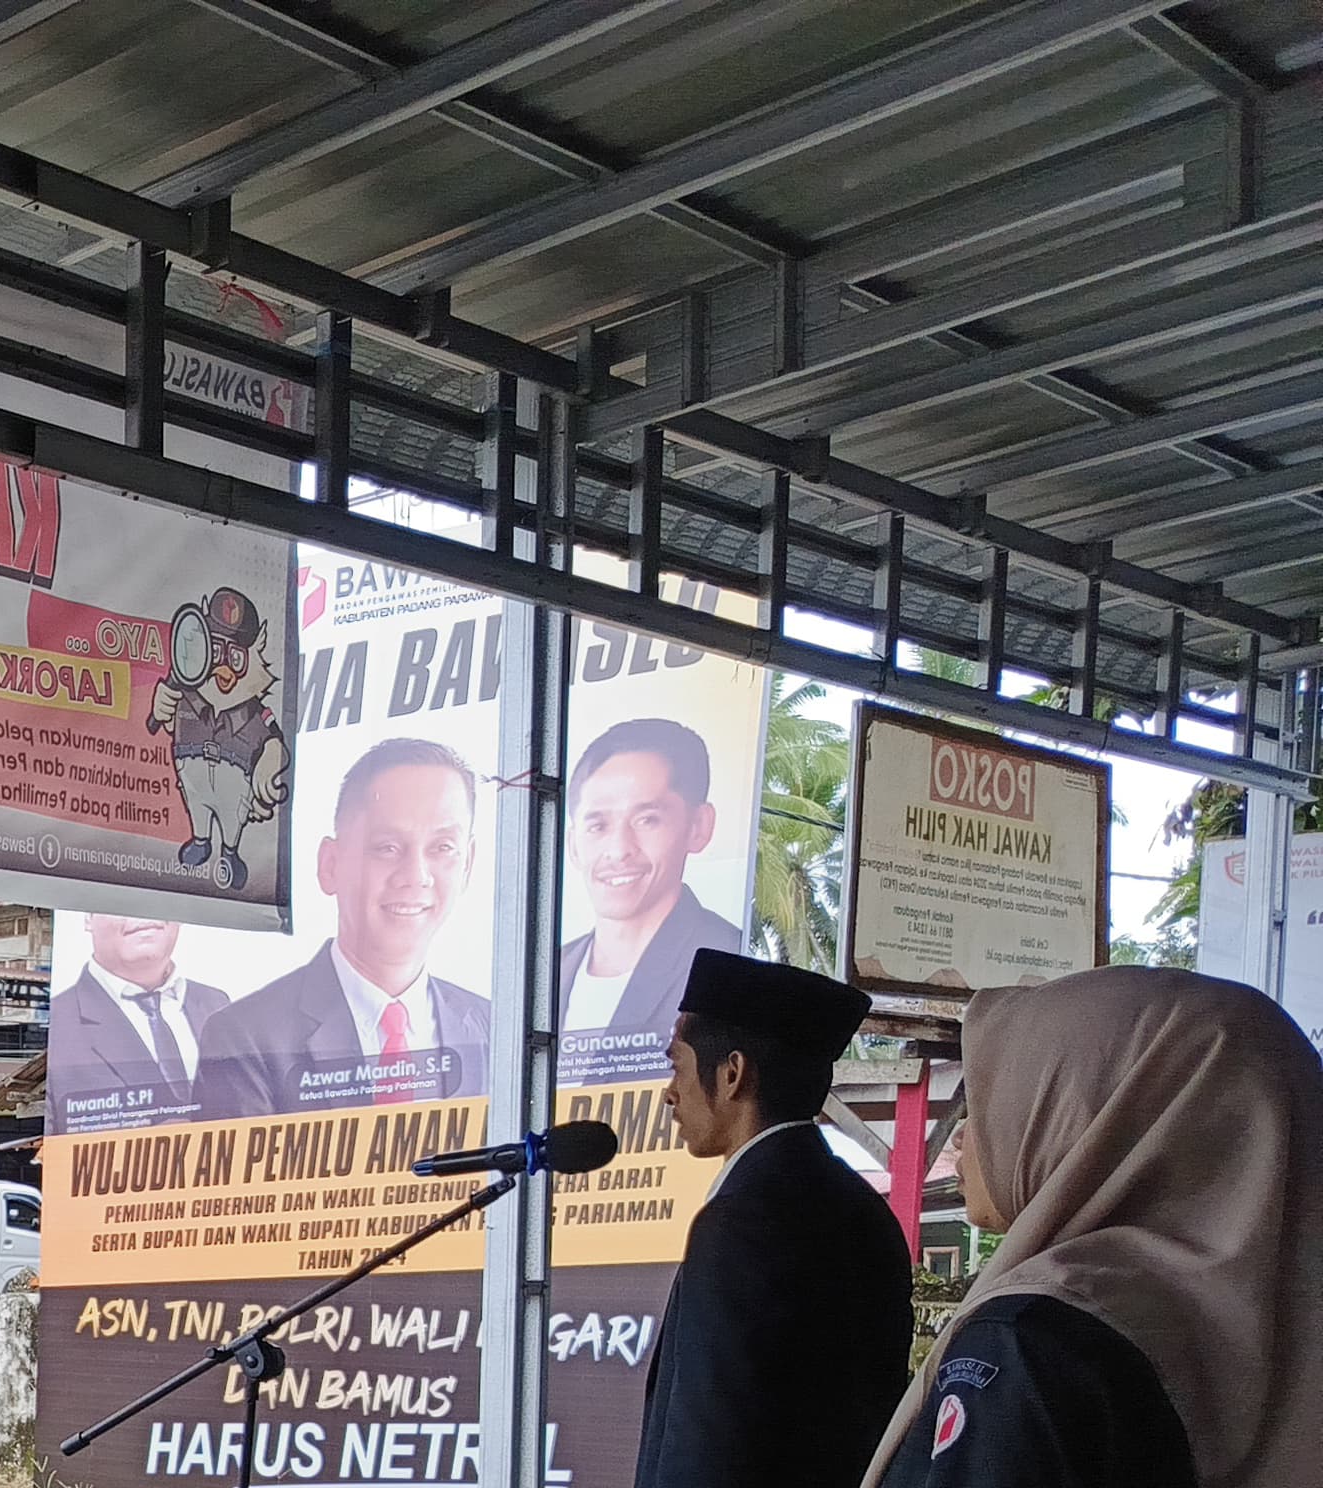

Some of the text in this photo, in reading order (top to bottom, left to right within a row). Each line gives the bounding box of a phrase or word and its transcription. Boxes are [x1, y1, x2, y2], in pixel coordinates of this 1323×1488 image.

[560, 1031, 663, 1054] Gunawan,
[299, 1055, 452, 1089] Azwar Mardin, S.E
[360, 1084, 393, 1096] Padang
[66, 1090, 154, 1114] Irwandi, S.Pt
[242, 1117, 360, 1184] PEMILU
[364, 1107, 470, 1175] AMAN
[105, 1201, 187, 1225] PEMILIHAN
[191, 1194, 278, 1219] GUBERNUR
[281, 1191, 317, 1213] DAN
[322, 1187, 376, 1210] WAKIL
[597, 1165, 667, 1192] BARAT
[91, 1232, 137, 1253] SERTA
[142, 1228, 198, 1250] BUPATI
[203, 1226, 237, 1246] DAN
[241, 1222, 293, 1244] WAKIL
[298, 1218, 360, 1241] BUPATI
[563, 1198, 675, 1226] PARIAMAN
[298, 1248, 354, 1270] TAHUN
[75, 1297, 159, 1343] ASN,
[164, 1300, 233, 1345] TNI,
[371, 1304, 471, 1353] WALI
[315, 1369, 458, 1418] BAMUS
[145, 1421, 573, 1481] HARUS NETRL
